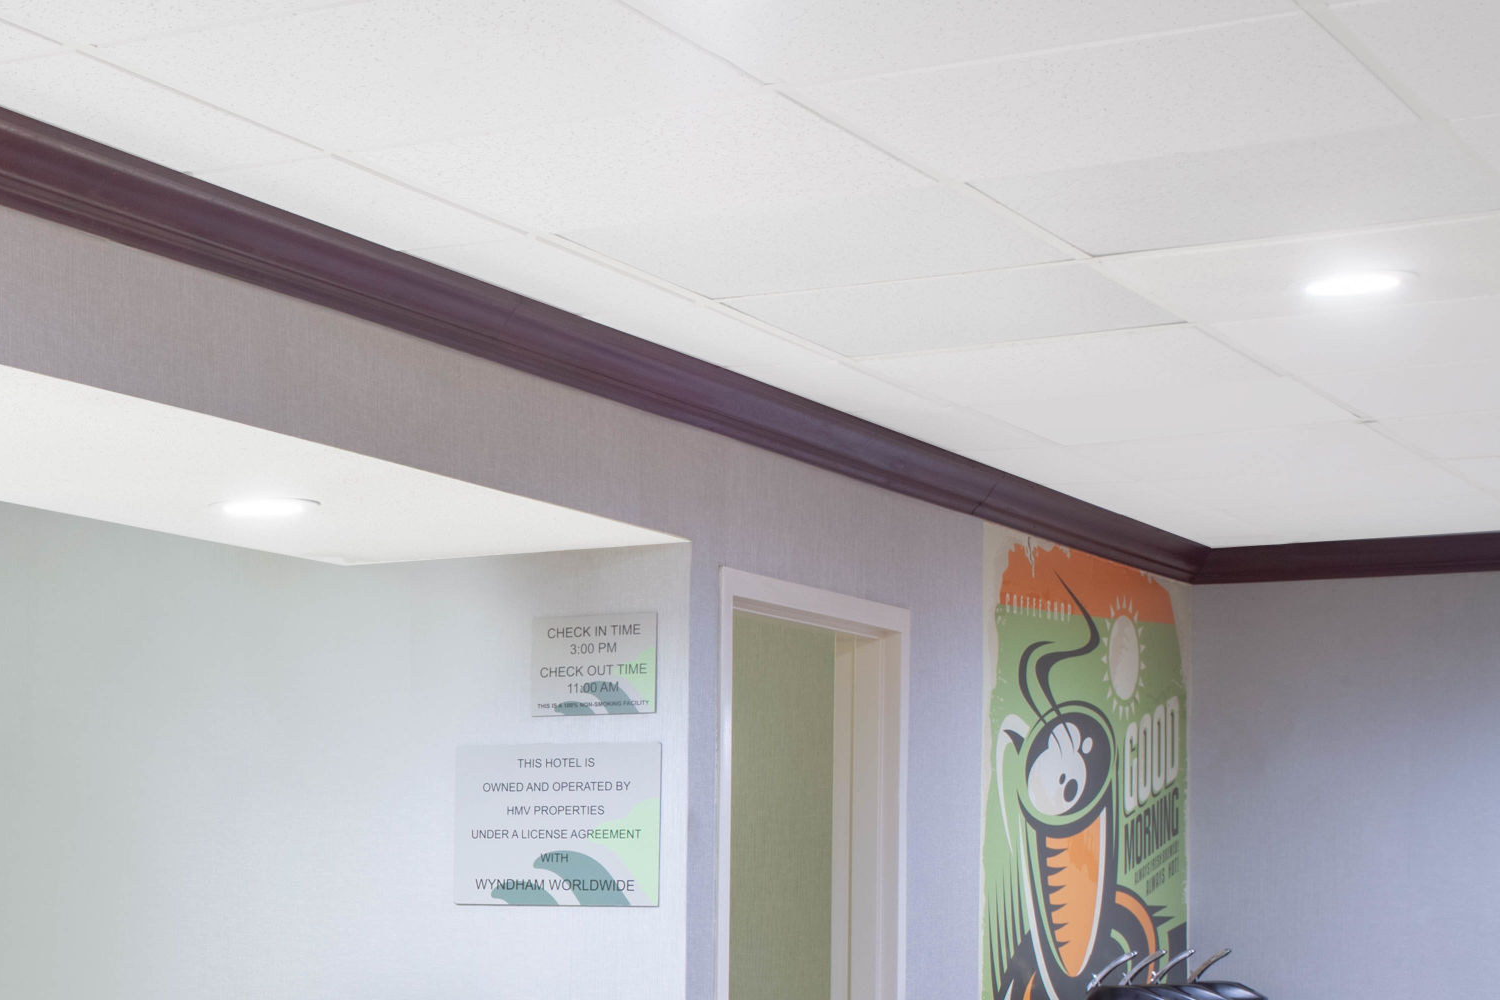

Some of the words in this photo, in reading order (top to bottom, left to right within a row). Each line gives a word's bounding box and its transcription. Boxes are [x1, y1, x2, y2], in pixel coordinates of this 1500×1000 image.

[547, 626, 591, 639] CHECK
[595, 625, 607, 637] IN
[610, 623, 641, 636] TIME
[570, 643, 595, 655] 3:00
[598, 642, 617, 653] PM
[540, 666, 584, 678] CHECK
[587, 664, 614, 676] OUT
[617, 663, 647, 674] TIME
[567, 682, 597, 694] 11:00
[600, 681, 619, 692] AM
[517, 758, 542, 768] THIS
[545, 757, 582, 768] HOTEL
[585, 757, 595, 768] IS
[1123, 695, 1179, 818] GOOD
[482, 782, 524, 792] OWNED
[526, 782, 549, 792] AND
[552, 781, 613, 792] OPERATED
[616, 781, 631, 791] BY
[506, 806, 531, 815] HMV
[533, 805, 605, 816] PROPERTIES
[471, 829, 509, 839] UNDER
[511, 829, 519, 839] A
[521, 829, 568, 839] LICENSE
[570, 829, 642, 839] AGREEMENT
[1123, 786, 1180, 875] MORNING
[540, 853, 569, 863] WITH
[475, 879, 545, 890] WYNDHAM
[548, 879, 635, 892] WORLDWIDE
